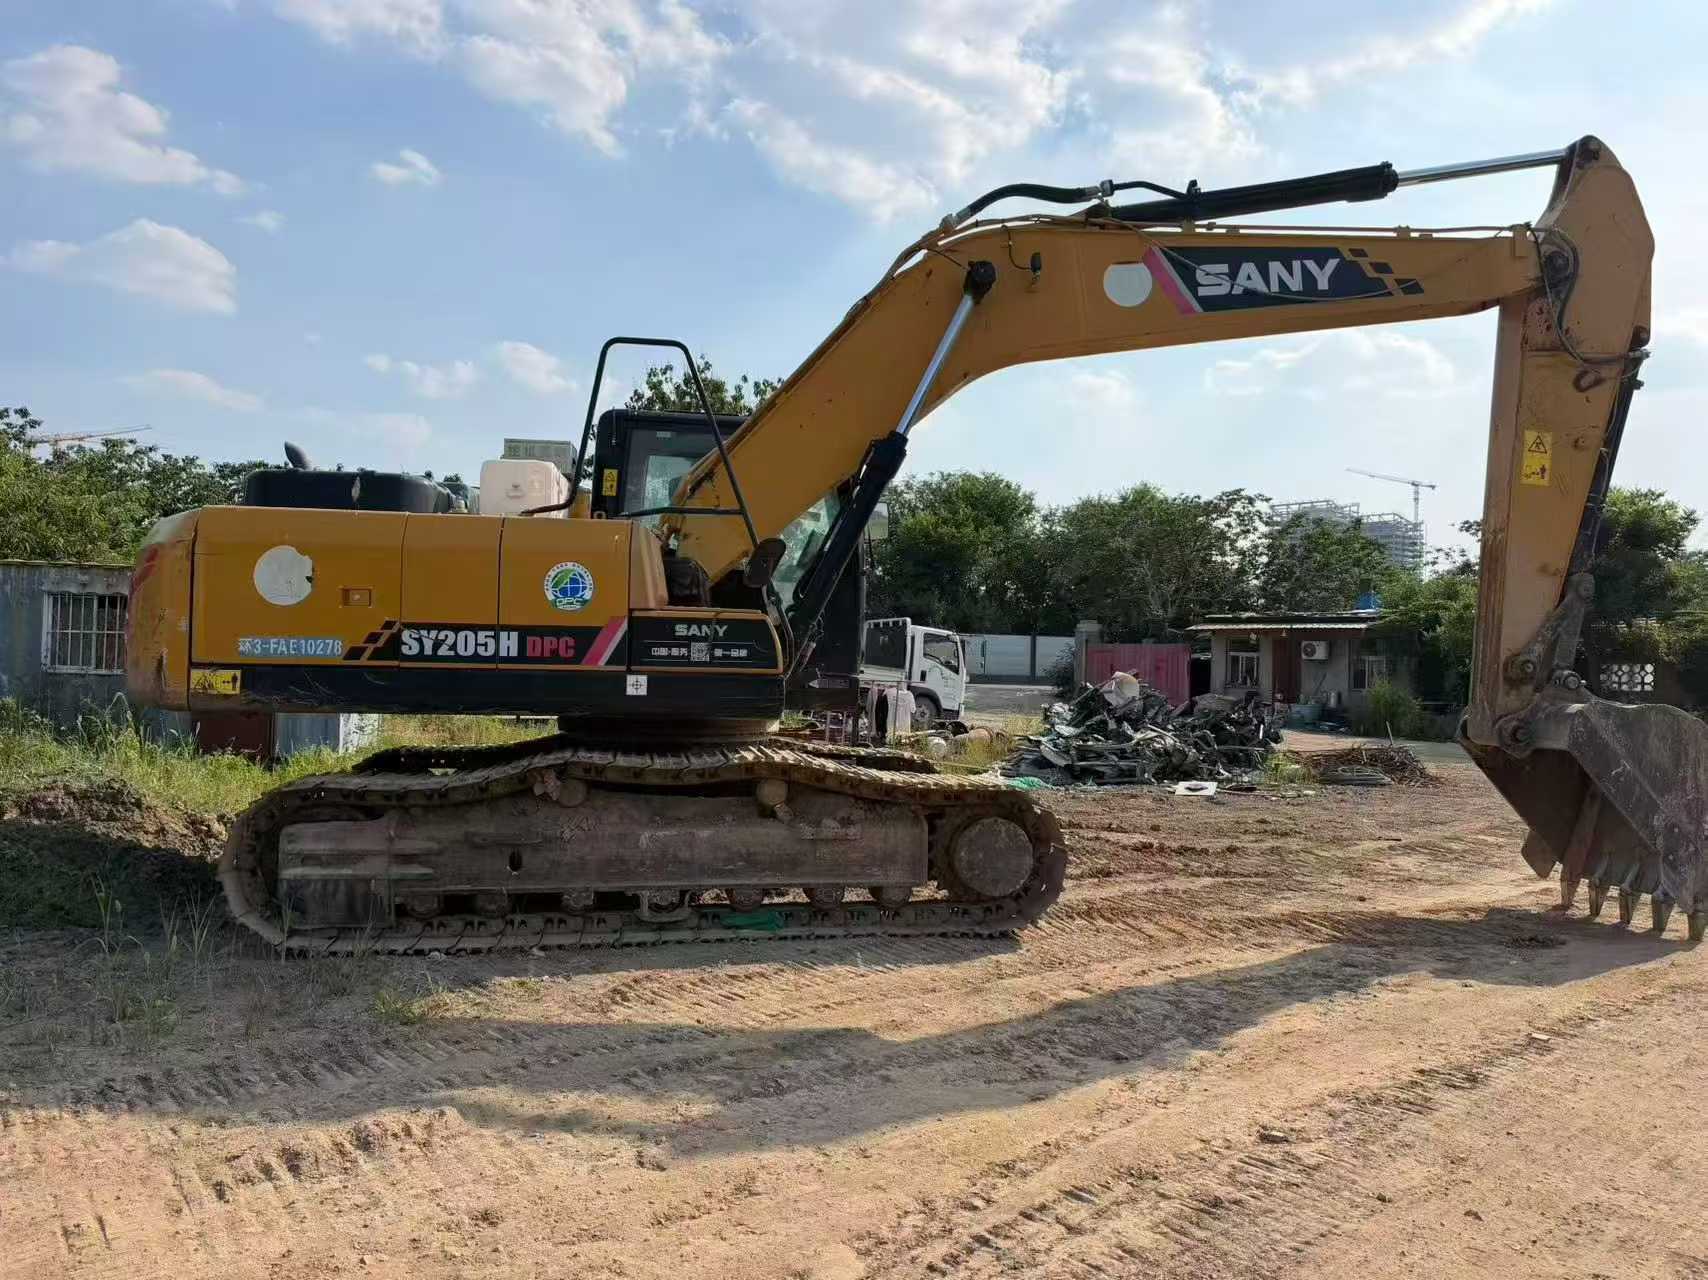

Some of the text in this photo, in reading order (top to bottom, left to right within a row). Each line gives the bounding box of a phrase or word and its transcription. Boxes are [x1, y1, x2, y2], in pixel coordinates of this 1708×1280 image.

[1195, 258, 1341, 297] SANY
[400, 629, 576, 658] SY205H DPC
[674, 624, 728, 637] SANY
